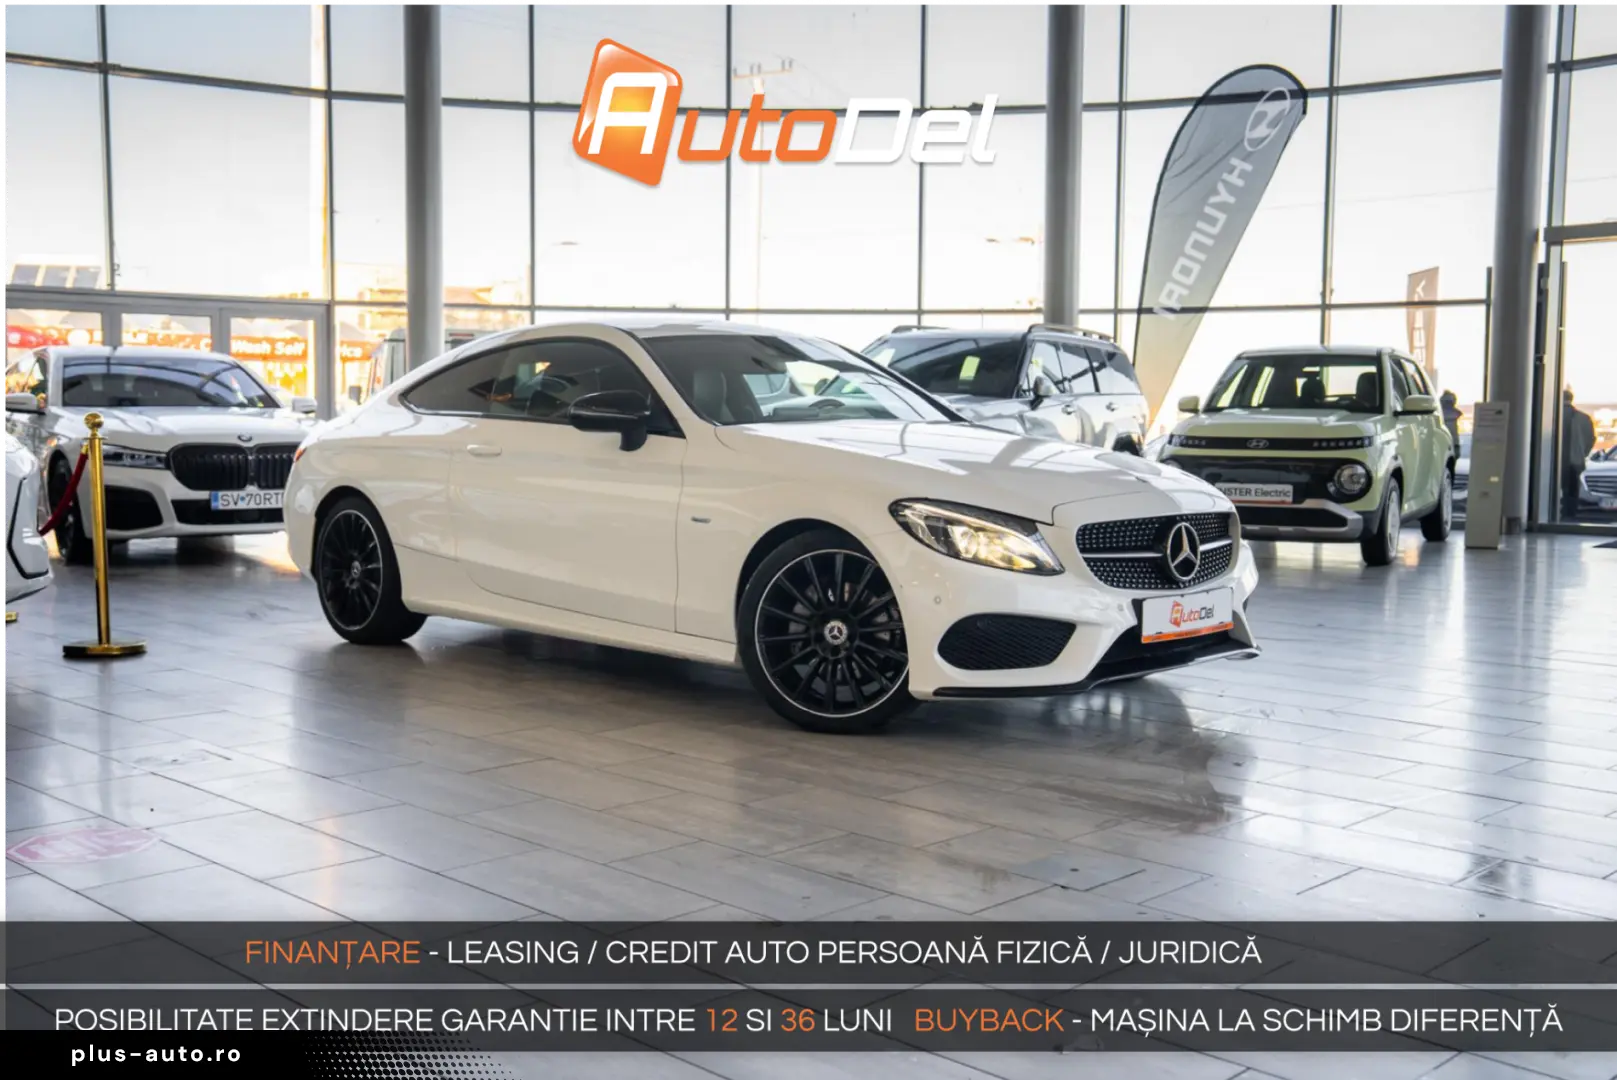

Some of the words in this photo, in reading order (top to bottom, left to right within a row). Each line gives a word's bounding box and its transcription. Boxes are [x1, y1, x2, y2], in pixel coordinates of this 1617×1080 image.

[220, 493, 240, 507] SV
[245, 492, 284, 506] 70RT
[1219, 487, 1252, 497] NSTER
[1254, 487, 1291, 498] Electric
[1170, 603, 1214, 625] AutoDel
